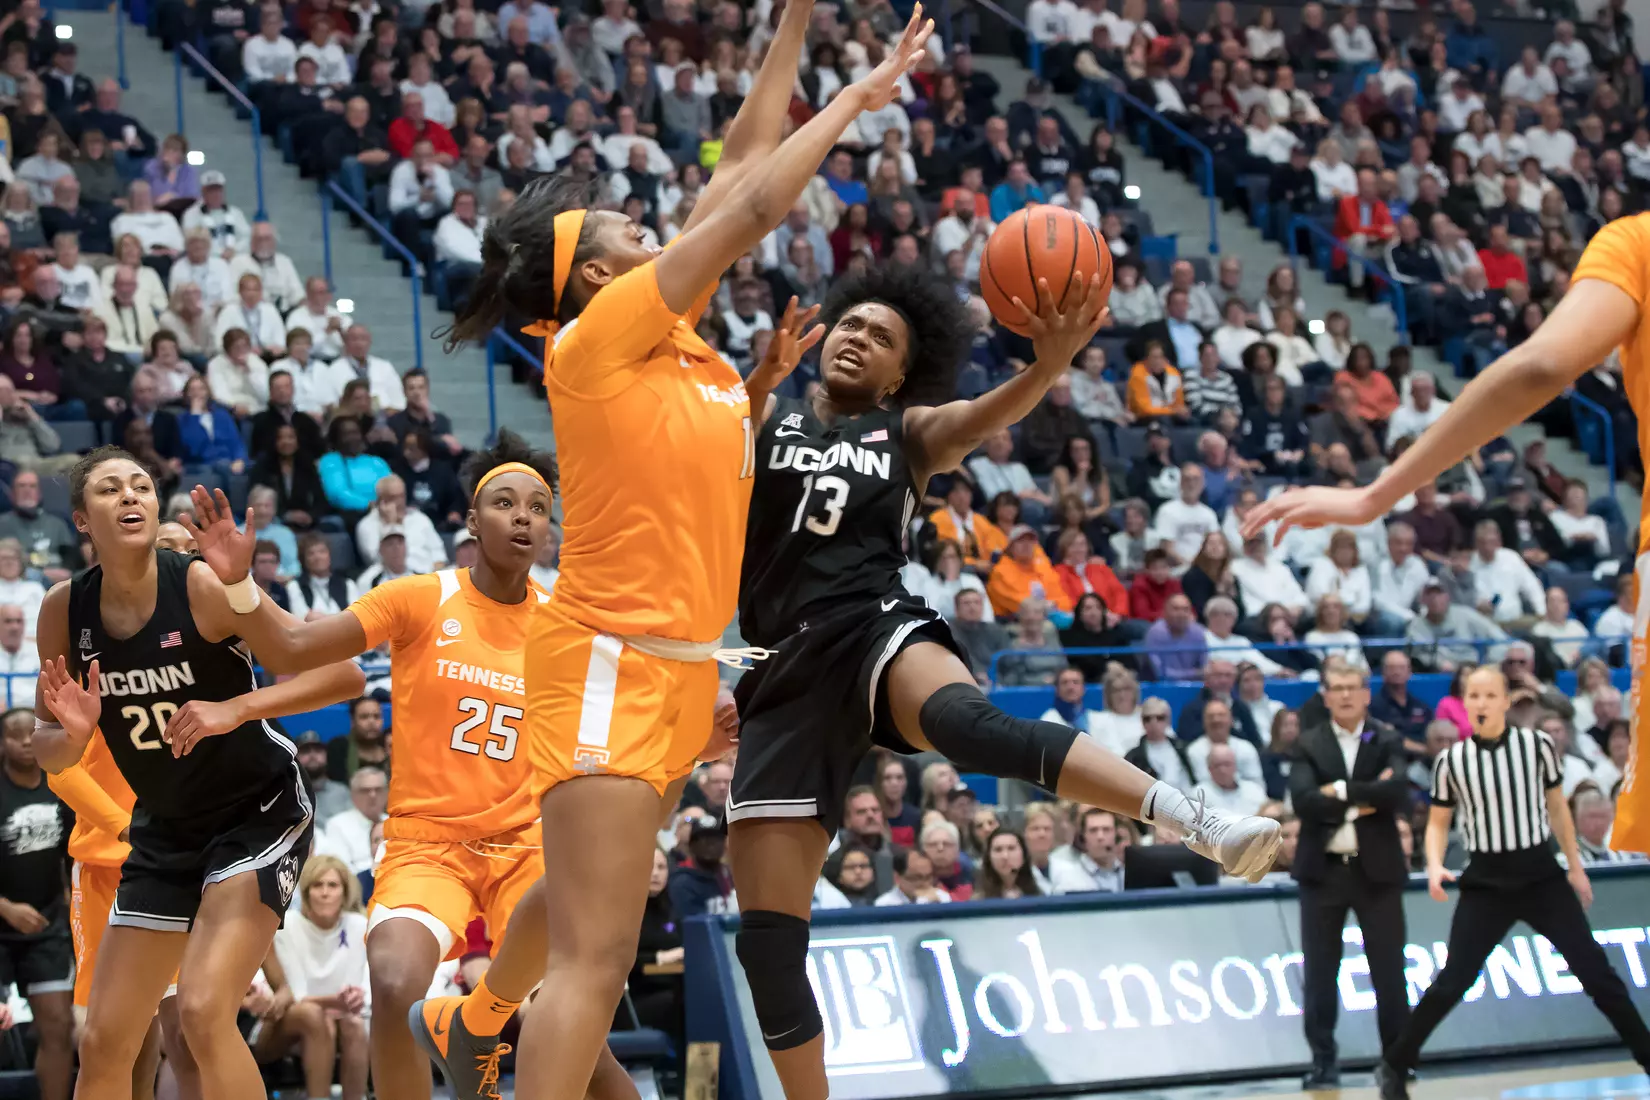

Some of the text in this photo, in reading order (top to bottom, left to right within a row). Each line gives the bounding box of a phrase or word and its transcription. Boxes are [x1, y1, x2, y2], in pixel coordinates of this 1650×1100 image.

[768, 441, 891, 480] UCONN
[791, 474, 850, 537] 13
[450, 696, 524, 762] 25
